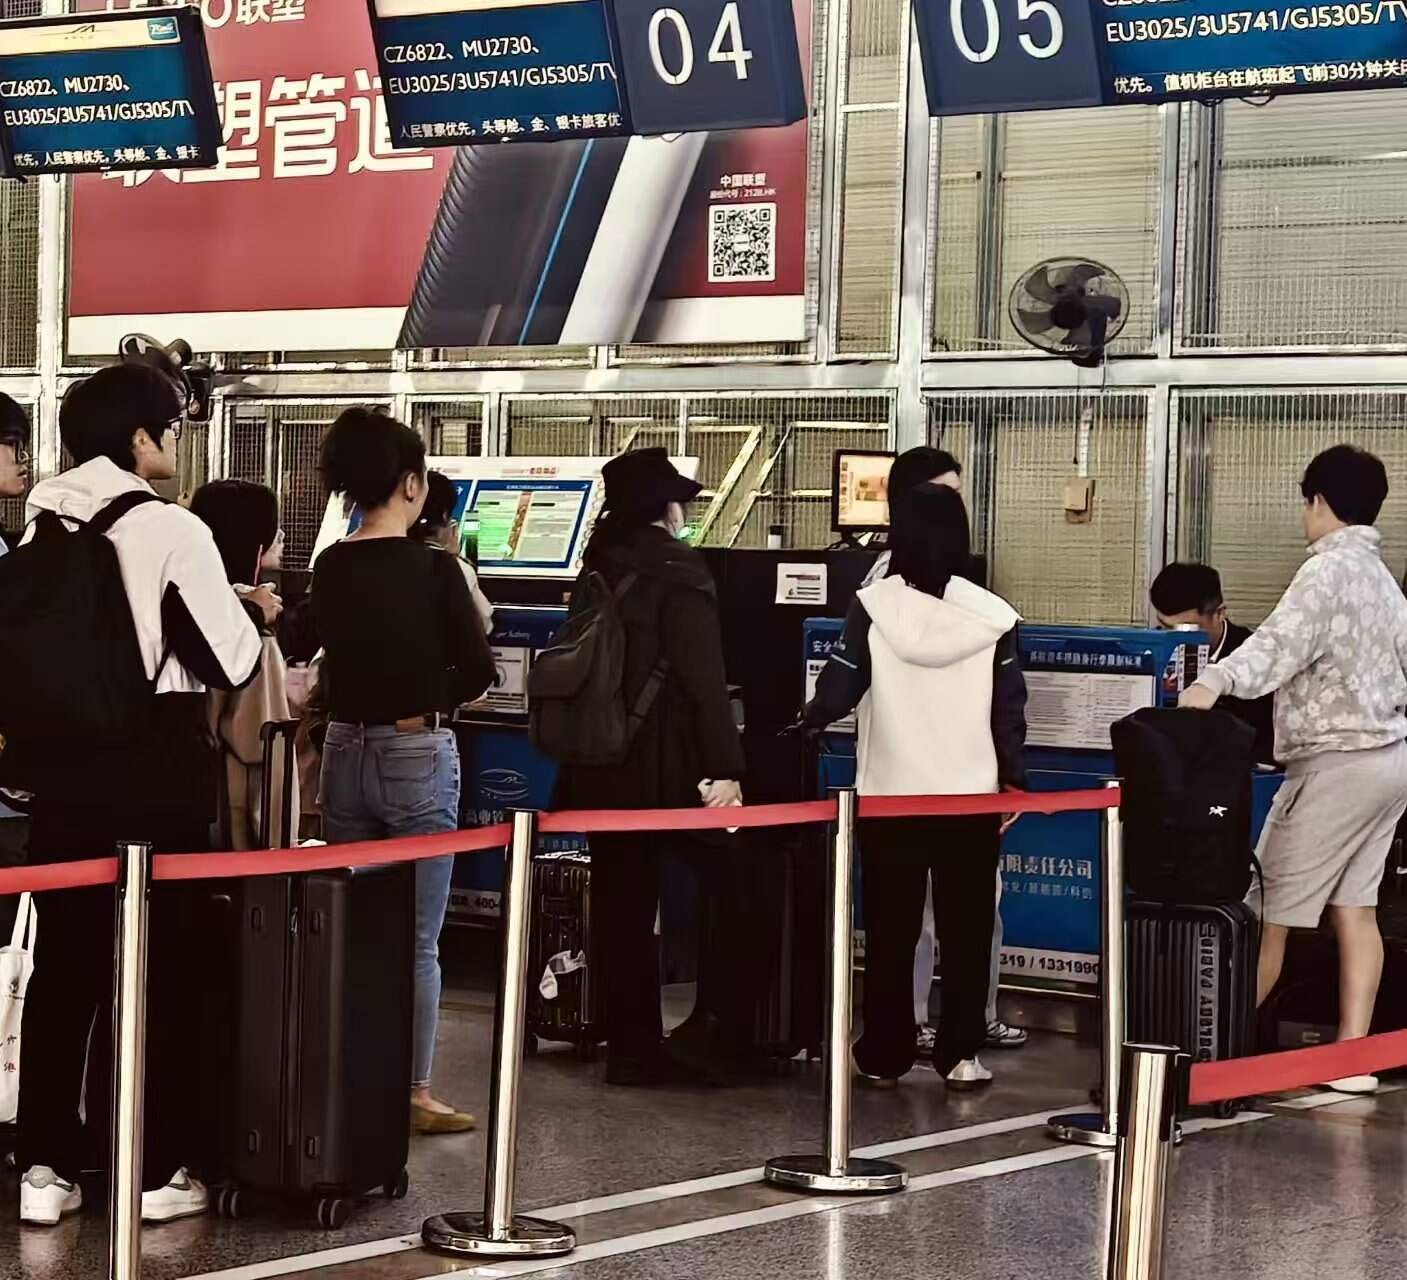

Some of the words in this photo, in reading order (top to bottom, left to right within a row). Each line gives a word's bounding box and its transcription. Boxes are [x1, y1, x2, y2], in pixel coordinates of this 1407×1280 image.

[648, 2, 753, 85] 04
[952, 0, 1064, 63] 05
[102, 69, 434, 187] 塑管道
